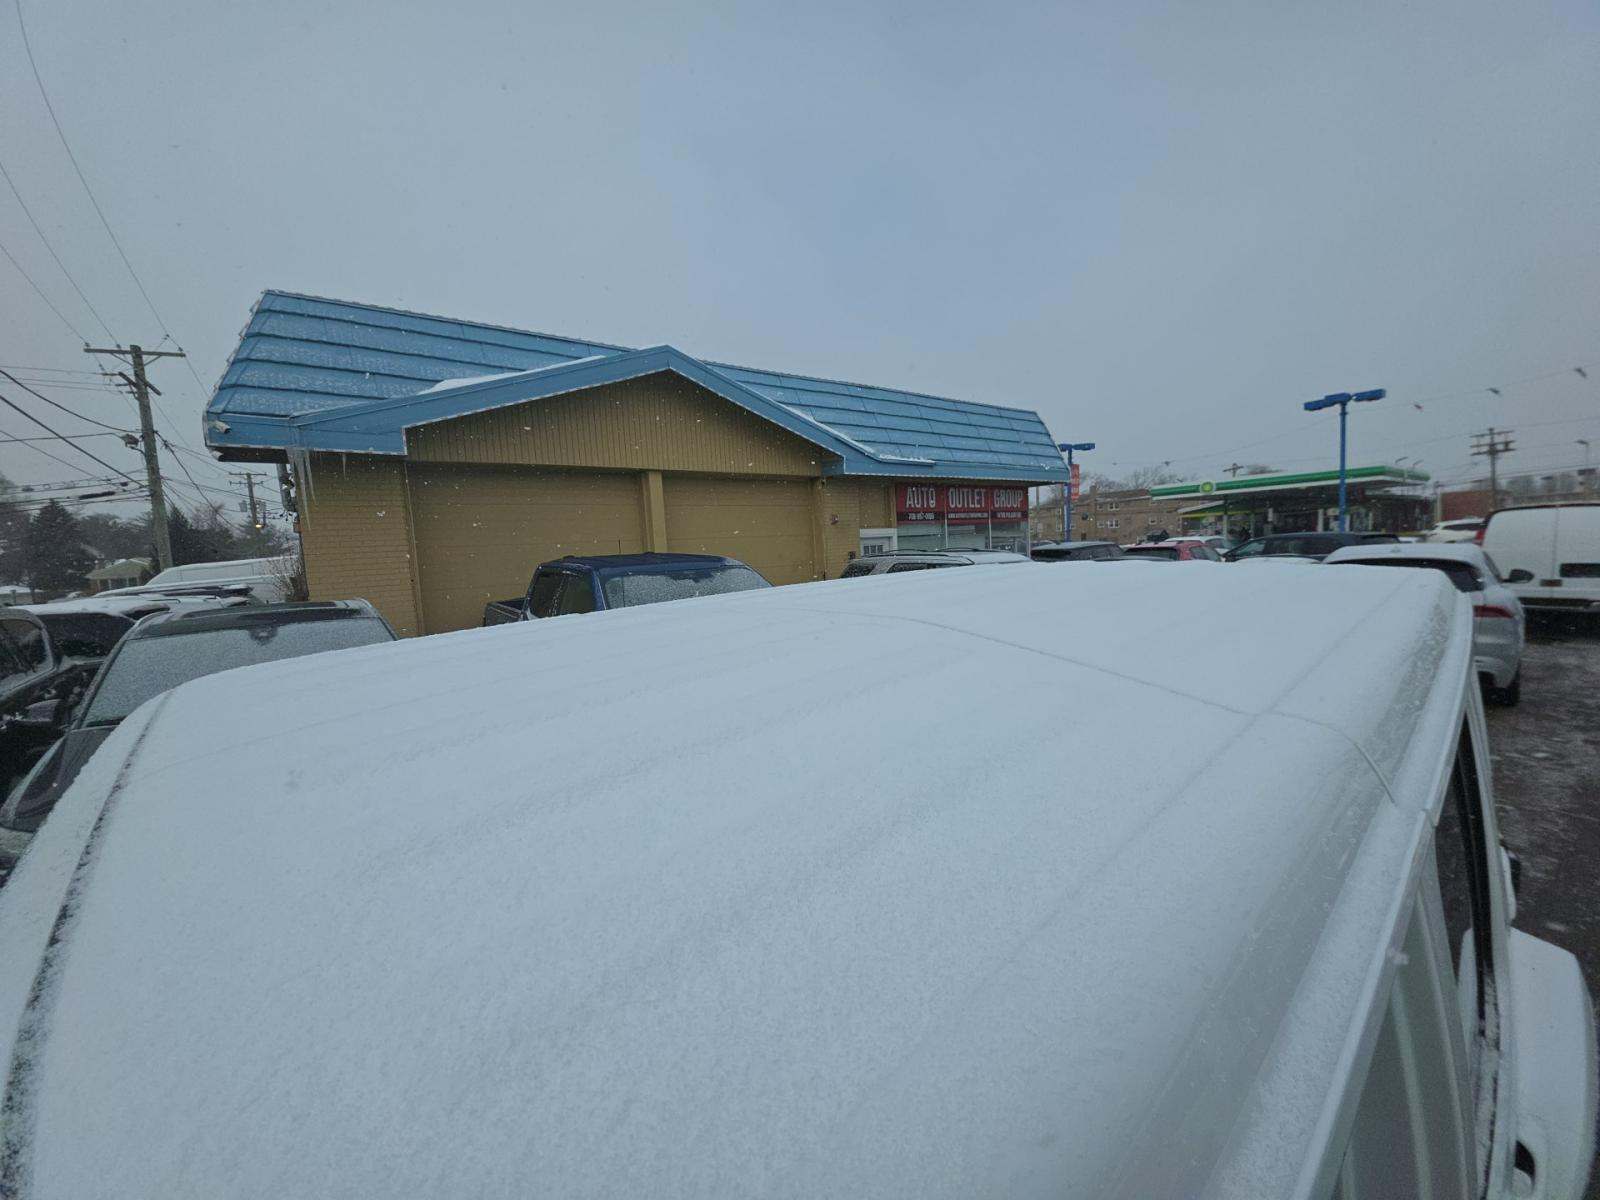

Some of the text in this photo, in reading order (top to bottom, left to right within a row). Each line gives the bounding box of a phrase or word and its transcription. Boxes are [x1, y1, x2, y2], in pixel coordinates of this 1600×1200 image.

[906, 487, 1023, 508] AUTO OUTLET GROUP
